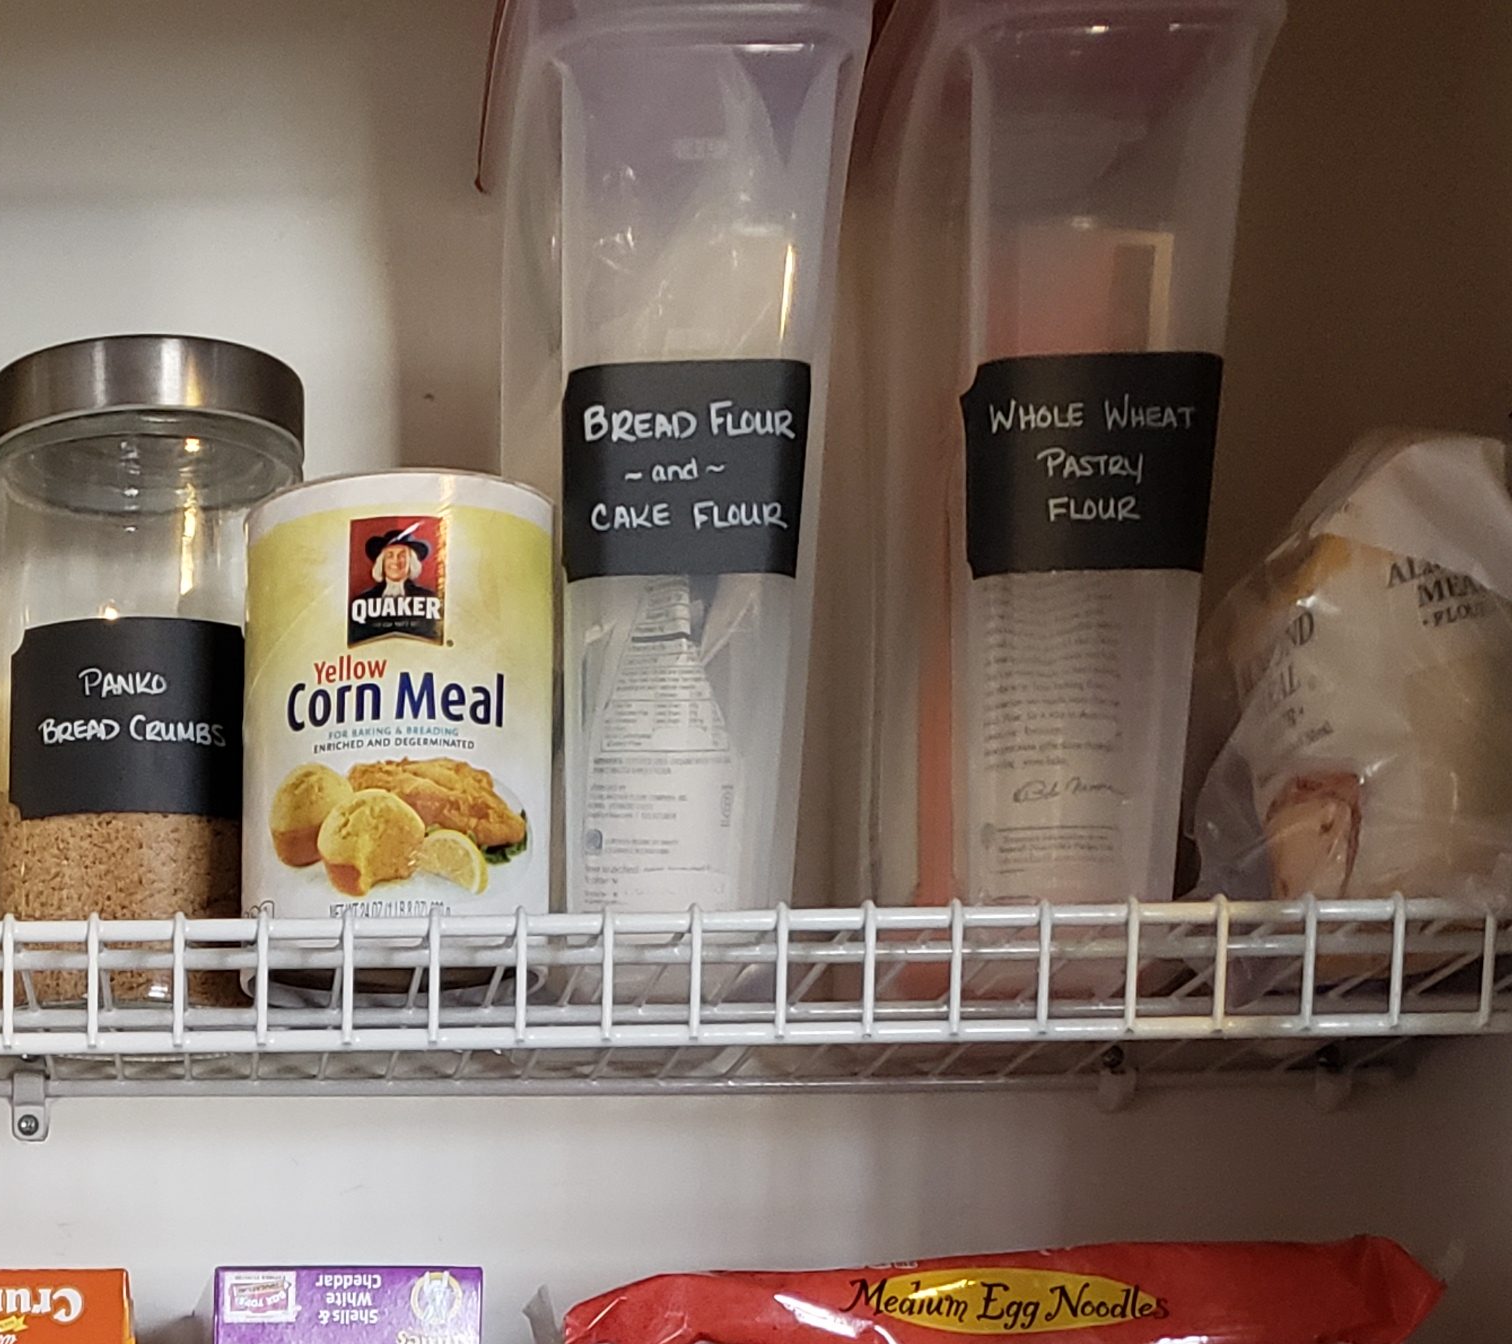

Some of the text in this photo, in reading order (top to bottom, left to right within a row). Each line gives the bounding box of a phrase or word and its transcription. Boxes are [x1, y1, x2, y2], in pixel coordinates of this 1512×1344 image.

[584, 400, 797, 443] BREAD FLOUR
[990, 395, 1196, 436] WHOLE WHEAT
[1037, 448, 1143, 485] PASTRY
[591, 500, 788, 532] CAKE FLOUR
[1048, 497, 1141, 523] FLOUR
[351, 597, 442, 621] QUAKER
[78, 668, 168, 697] PANKO
[313, 655, 387, 684] Yellow
[287, 672, 505, 730] Corn Meal
[39, 714, 227, 749] BREAD CRUMBS
[315, 1274, 382, 1289] Cheddar
[326, 1293, 373, 1307] White
[840, 1278, 1169, 1330] Medium Egg Noodles
[318, 1309, 379, 1325] Shells &
